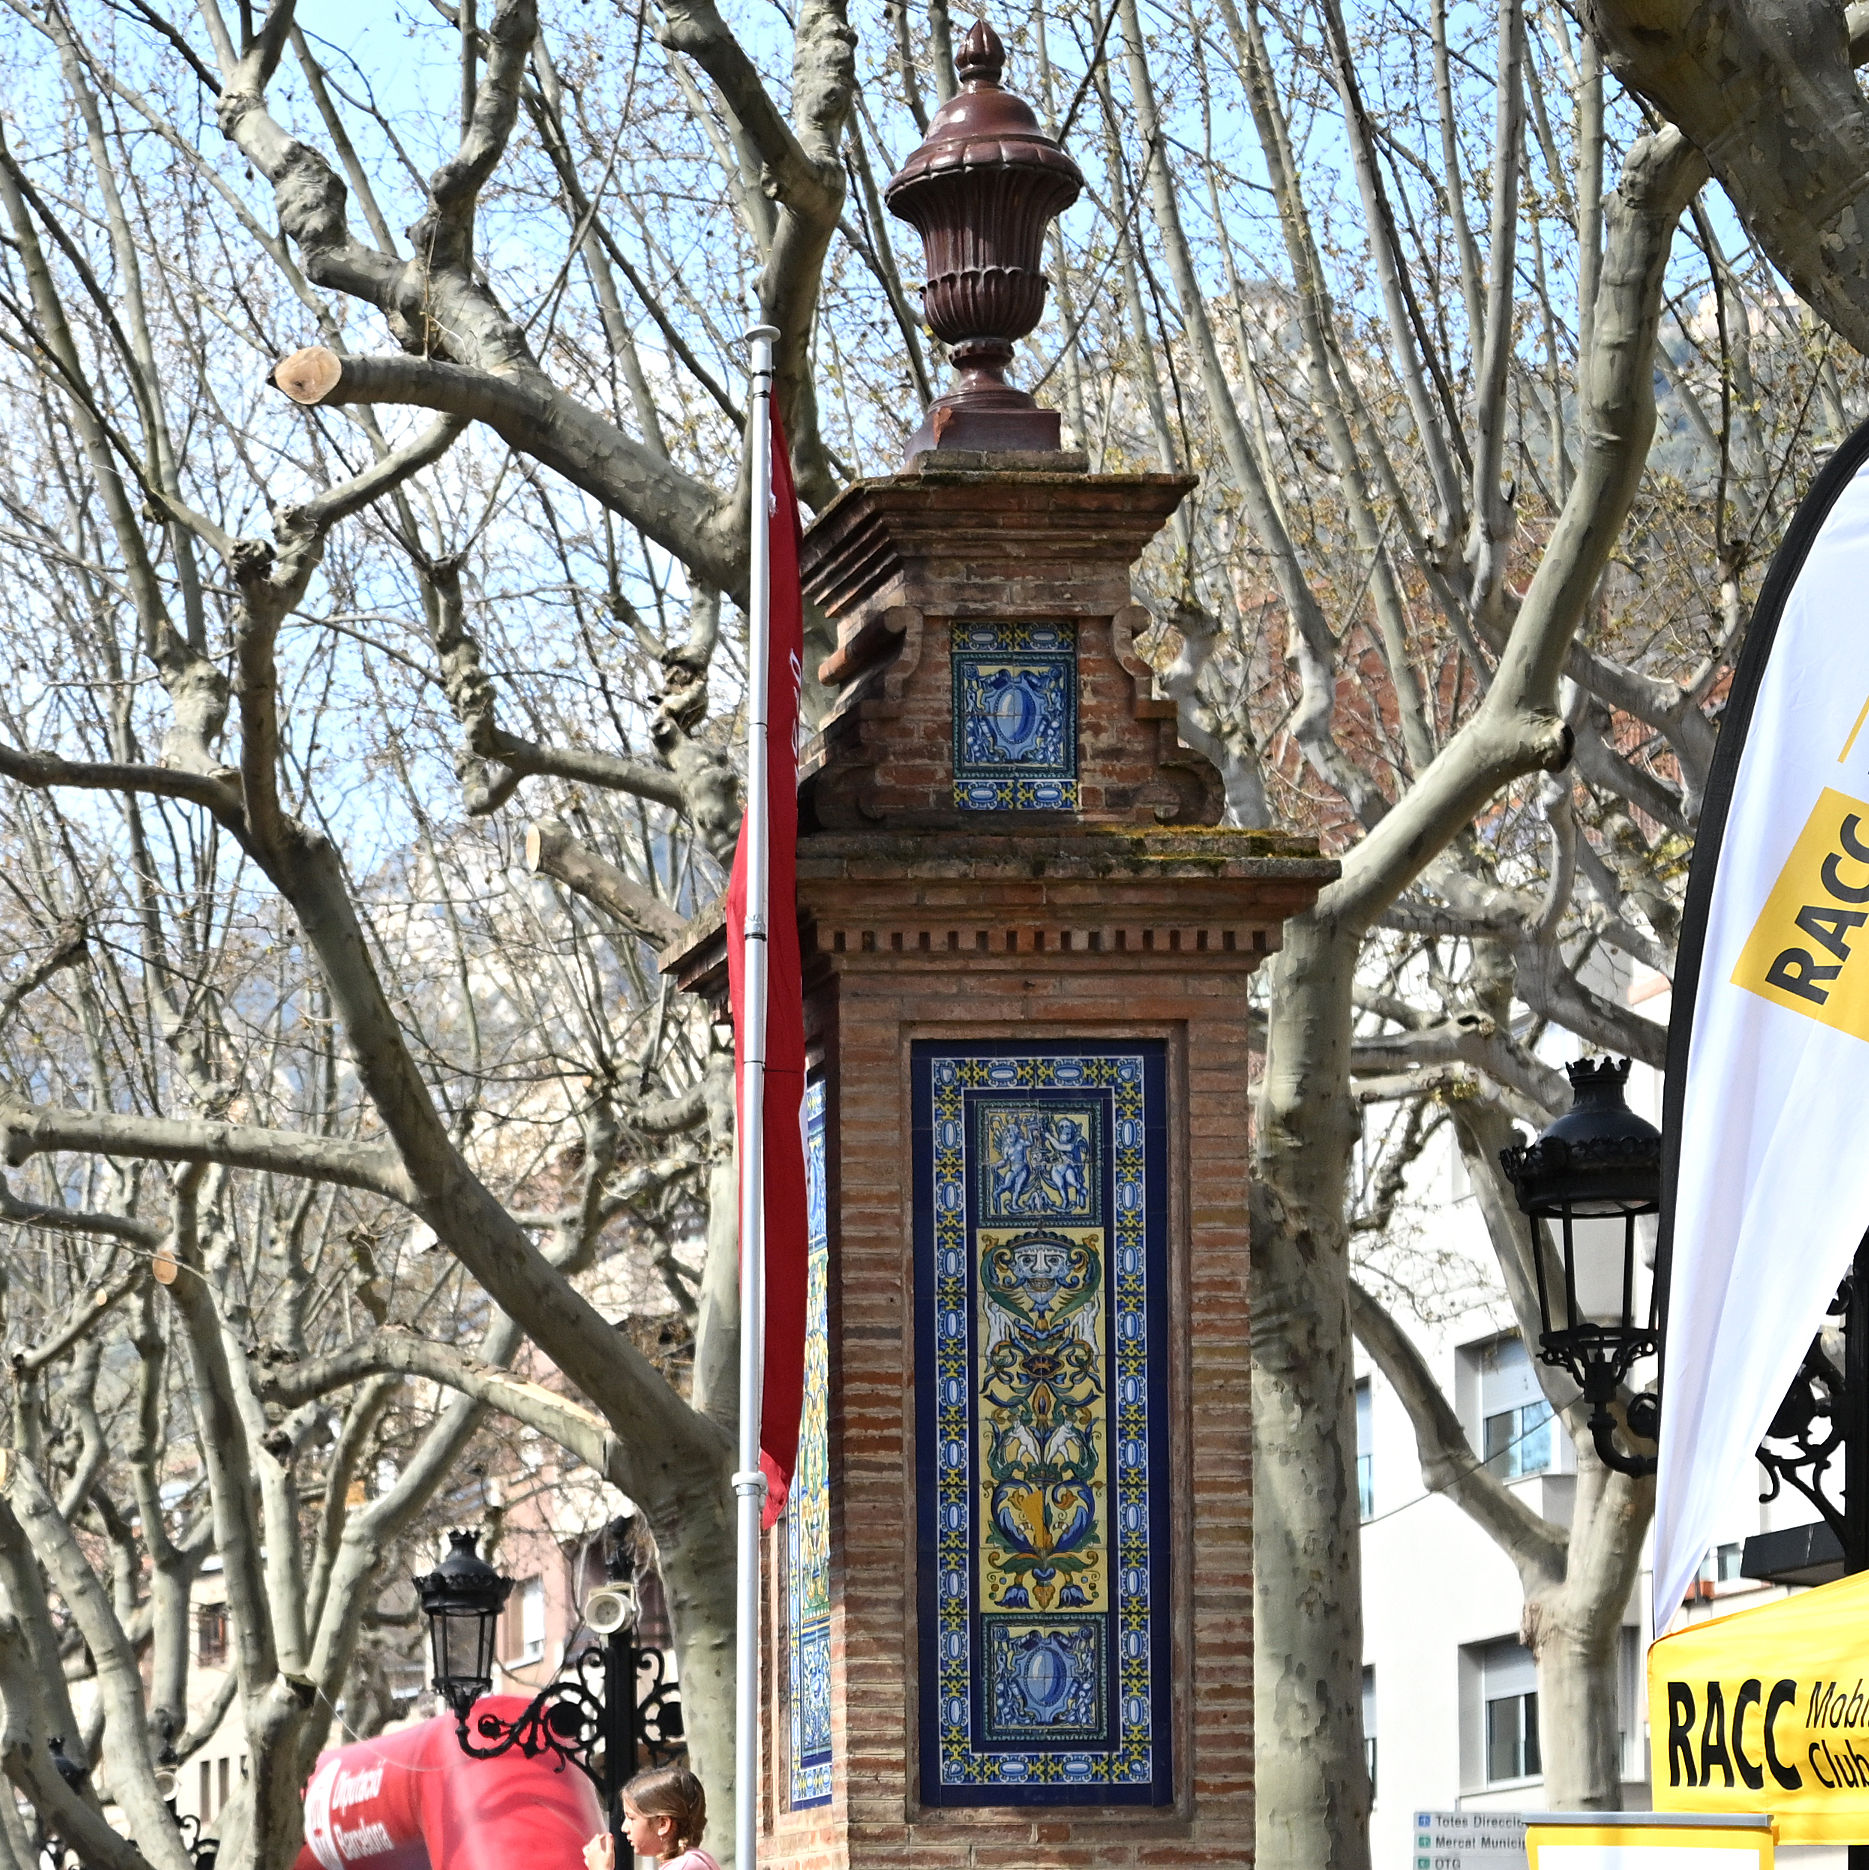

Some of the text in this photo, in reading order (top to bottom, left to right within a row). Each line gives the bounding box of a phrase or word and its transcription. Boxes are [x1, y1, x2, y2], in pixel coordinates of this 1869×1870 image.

[1667, 1678, 1803, 1791] RACC
[1436, 1815, 1468, 1828] Totes
[1435, 1836, 1476, 1850] Mercat
